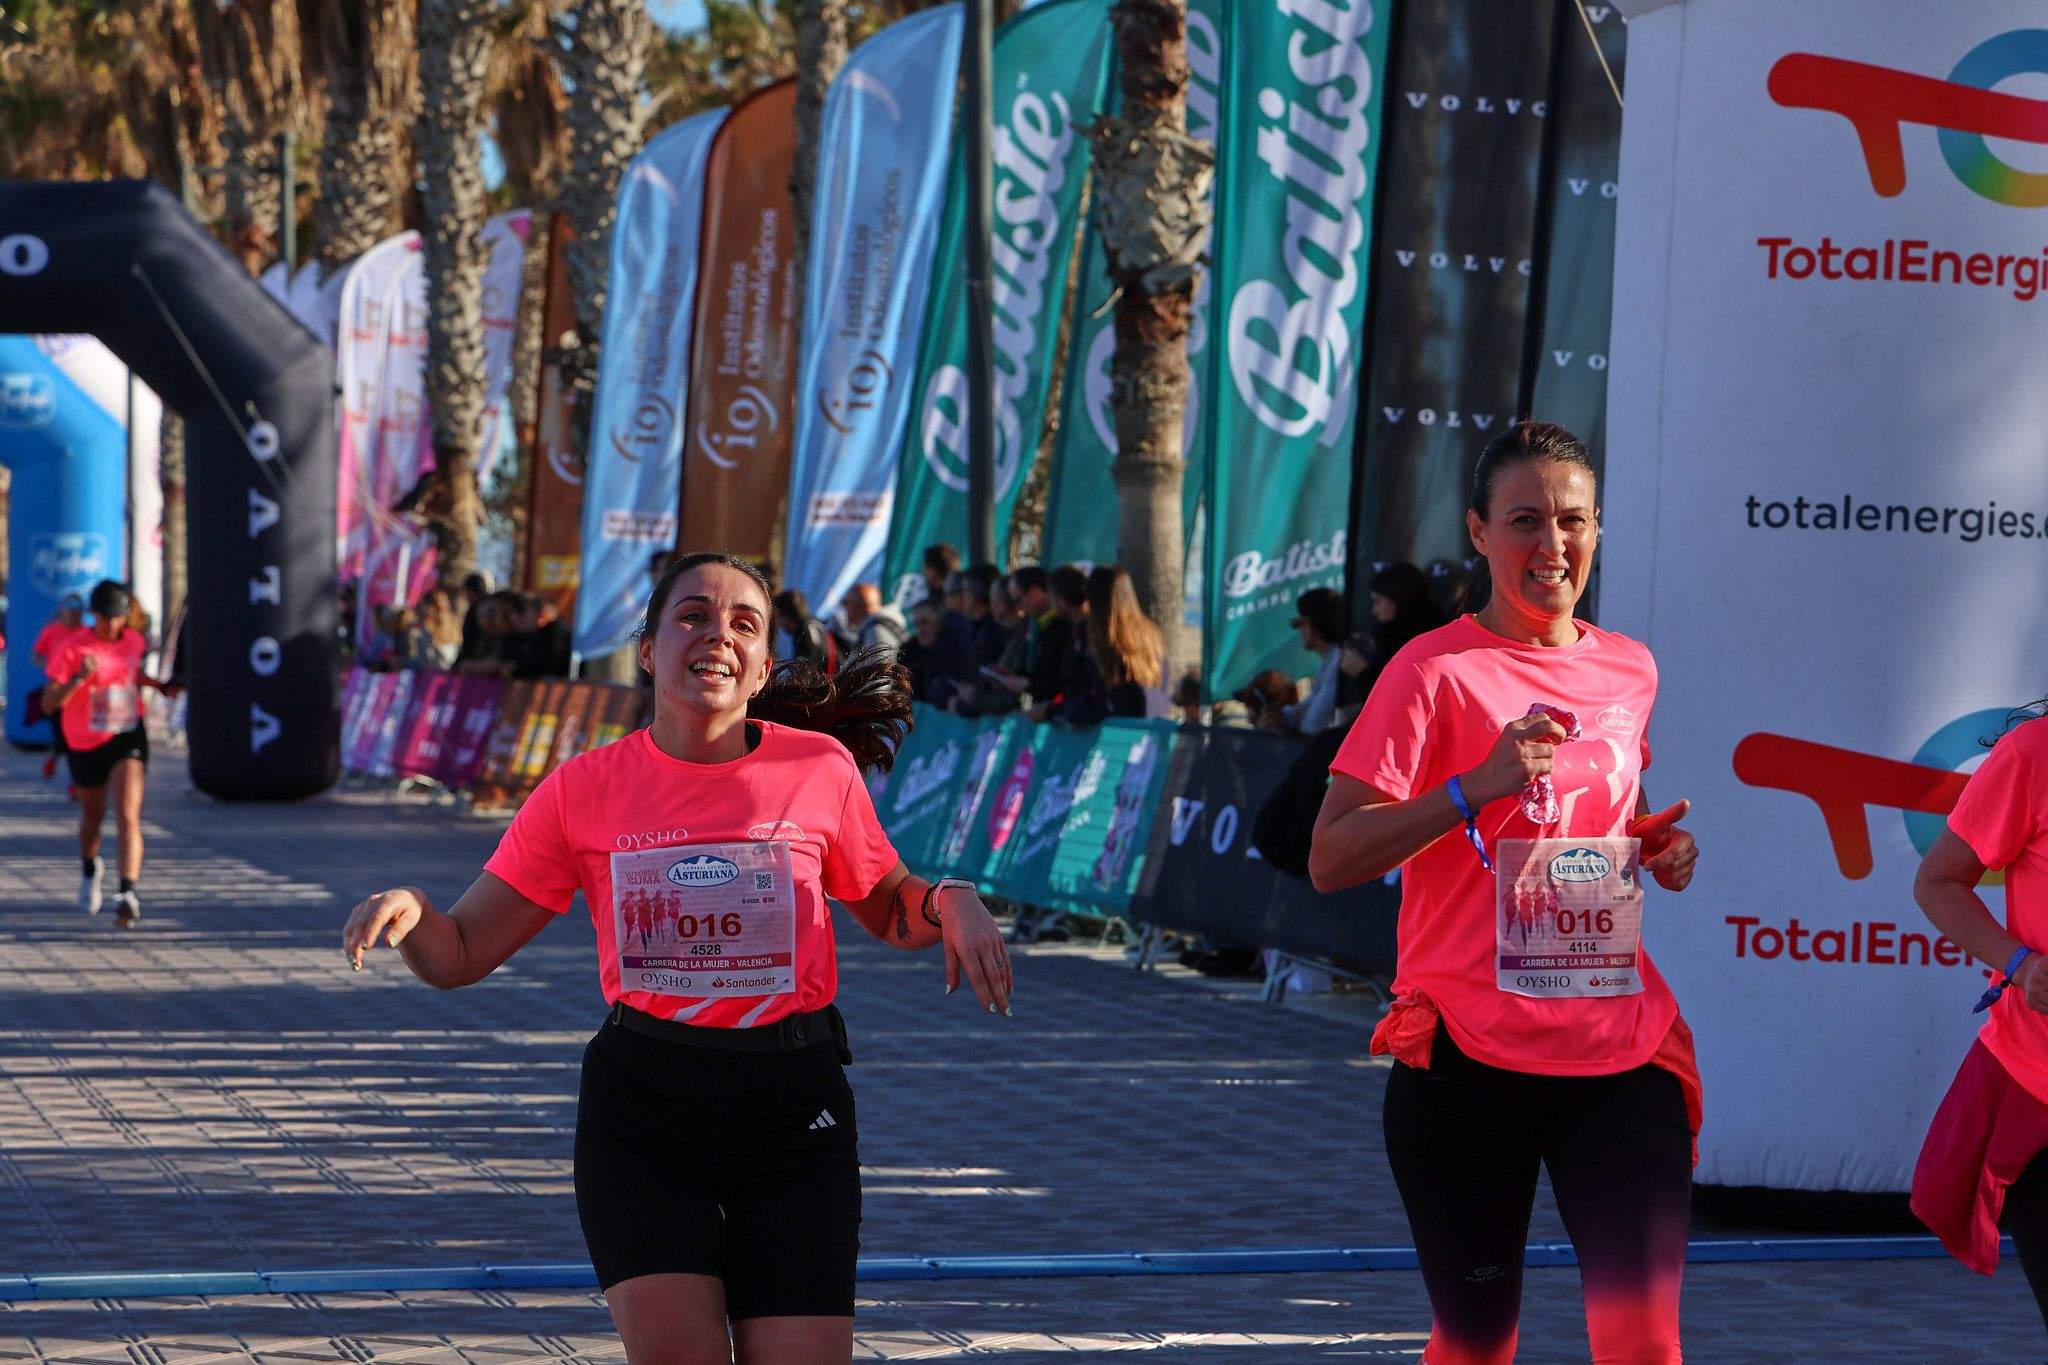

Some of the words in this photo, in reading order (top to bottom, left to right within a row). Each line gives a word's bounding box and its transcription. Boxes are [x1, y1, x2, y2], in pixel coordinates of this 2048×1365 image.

[1745, 495, 2048, 542] totalenergies.
[248, 420, 282, 752] VOLVO
[1170, 796, 1262, 859] VO
[616, 828, 689, 849] OYSHO
[673, 867, 734, 881] ASTURIANA
[1553, 863, 1606, 874] ASTURIANA
[627, 876, 661, 885] SUMA
[677, 912, 742, 939] 016
[1556, 908, 1613, 934] 016
[691, 944, 722, 956] 4528
[1569, 941, 1597, 953] 4114
[642, 959, 677, 968] CARRERA
[679, 960, 689, 969] DE
[690, 960, 700, 969] LA
[702, 960, 730, 968] MUJER
[737, 957, 773, 967] VALENCIA
[1520, 958, 1555, 967] CARRERA
[1558, 958, 1567, 967] DE
[1570, 958, 1578, 967] LA
[1581, 957, 1604, 967] MUJER
[641, 973, 692, 989] OYSHO
[726, 976, 776, 989] Santander
[1516, 975, 1571, 988] OYSHO
